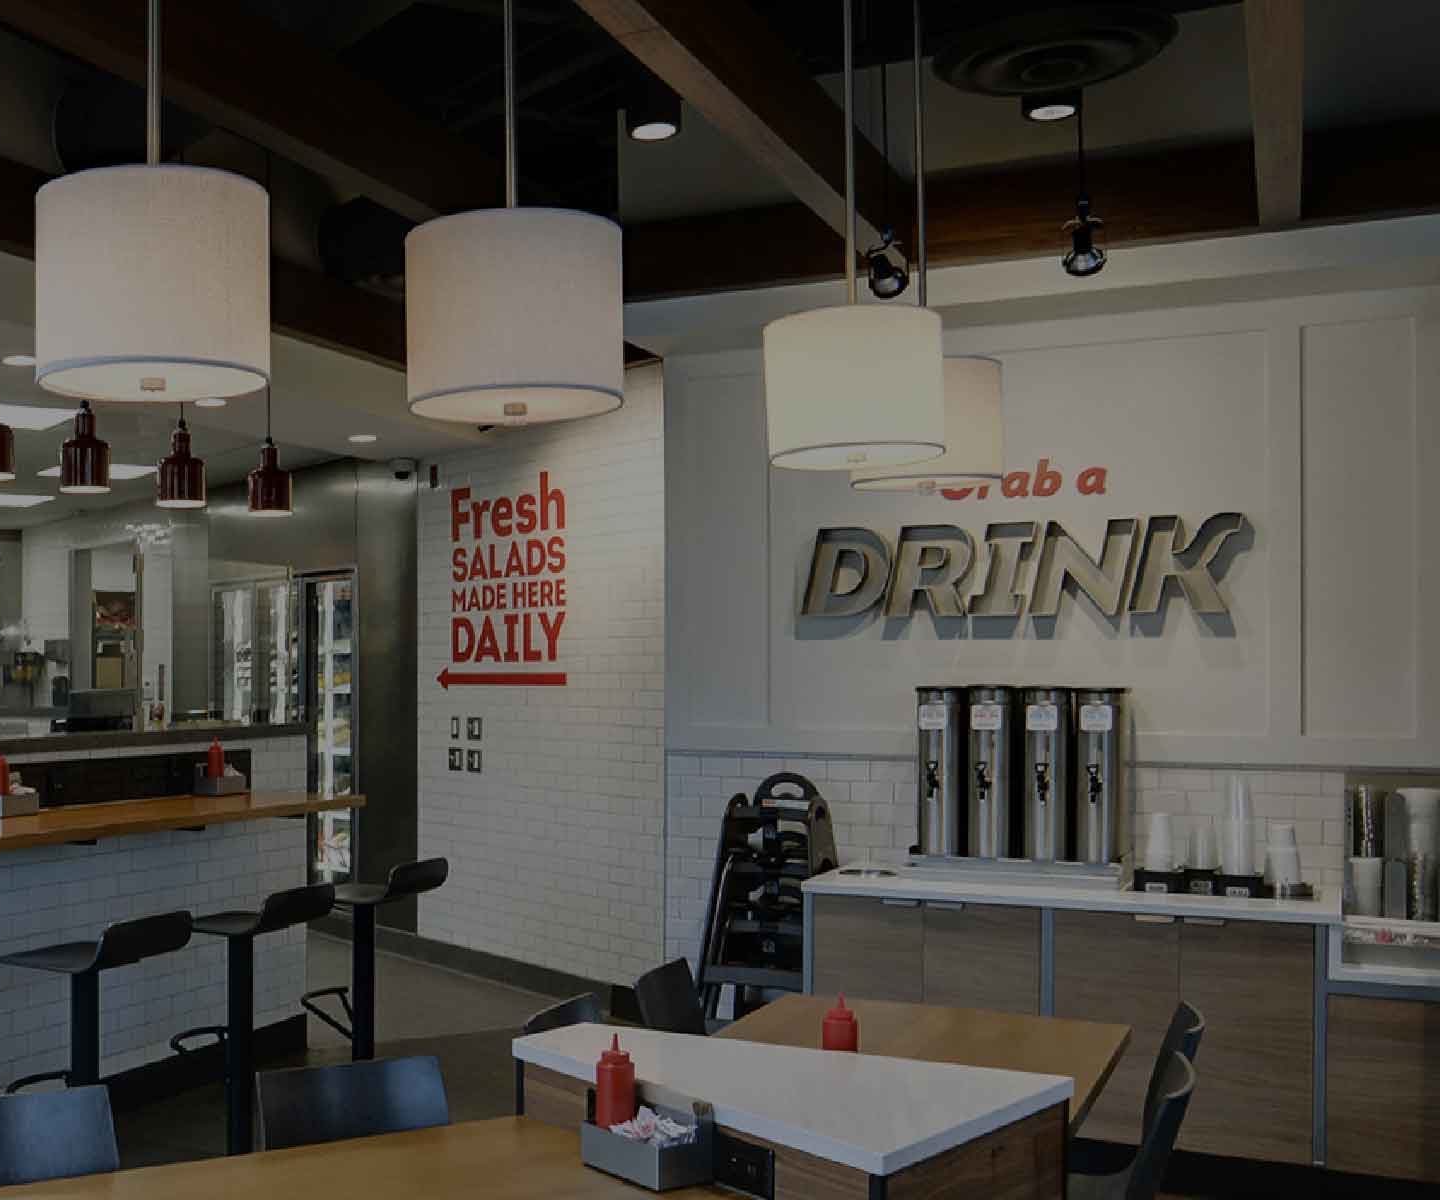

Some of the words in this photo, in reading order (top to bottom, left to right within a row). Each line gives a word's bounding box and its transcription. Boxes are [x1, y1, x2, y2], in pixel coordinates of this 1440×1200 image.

[1076, 467, 1107, 495] a
[451, 472, 566, 542] Fresh
[451, 536, 566, 582] SALADS
[800, 511, 1244, 617] DRINK
[451, 583, 508, 612] MADE
[512, 579, 567, 608] HERE
[451, 611, 567, 663] DAILY
